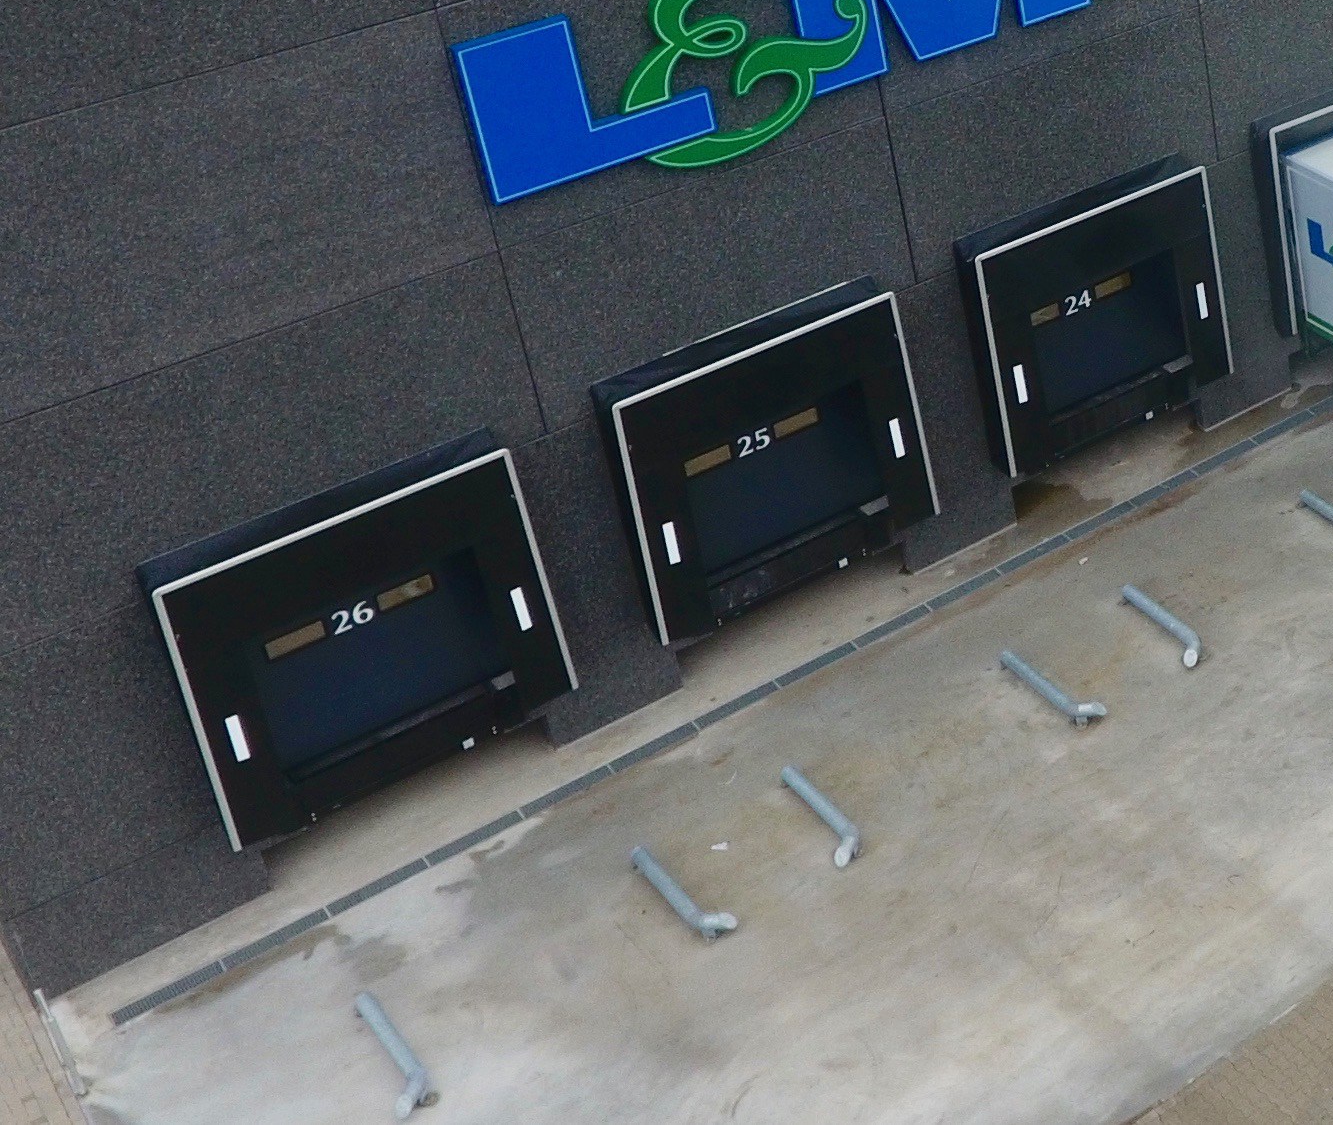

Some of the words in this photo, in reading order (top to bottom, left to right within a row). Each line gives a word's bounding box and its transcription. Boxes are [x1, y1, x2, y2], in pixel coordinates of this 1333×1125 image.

[1064, 289, 1093, 316] 24
[737, 427, 771, 458] 25
[331, 600, 375, 635] 26
